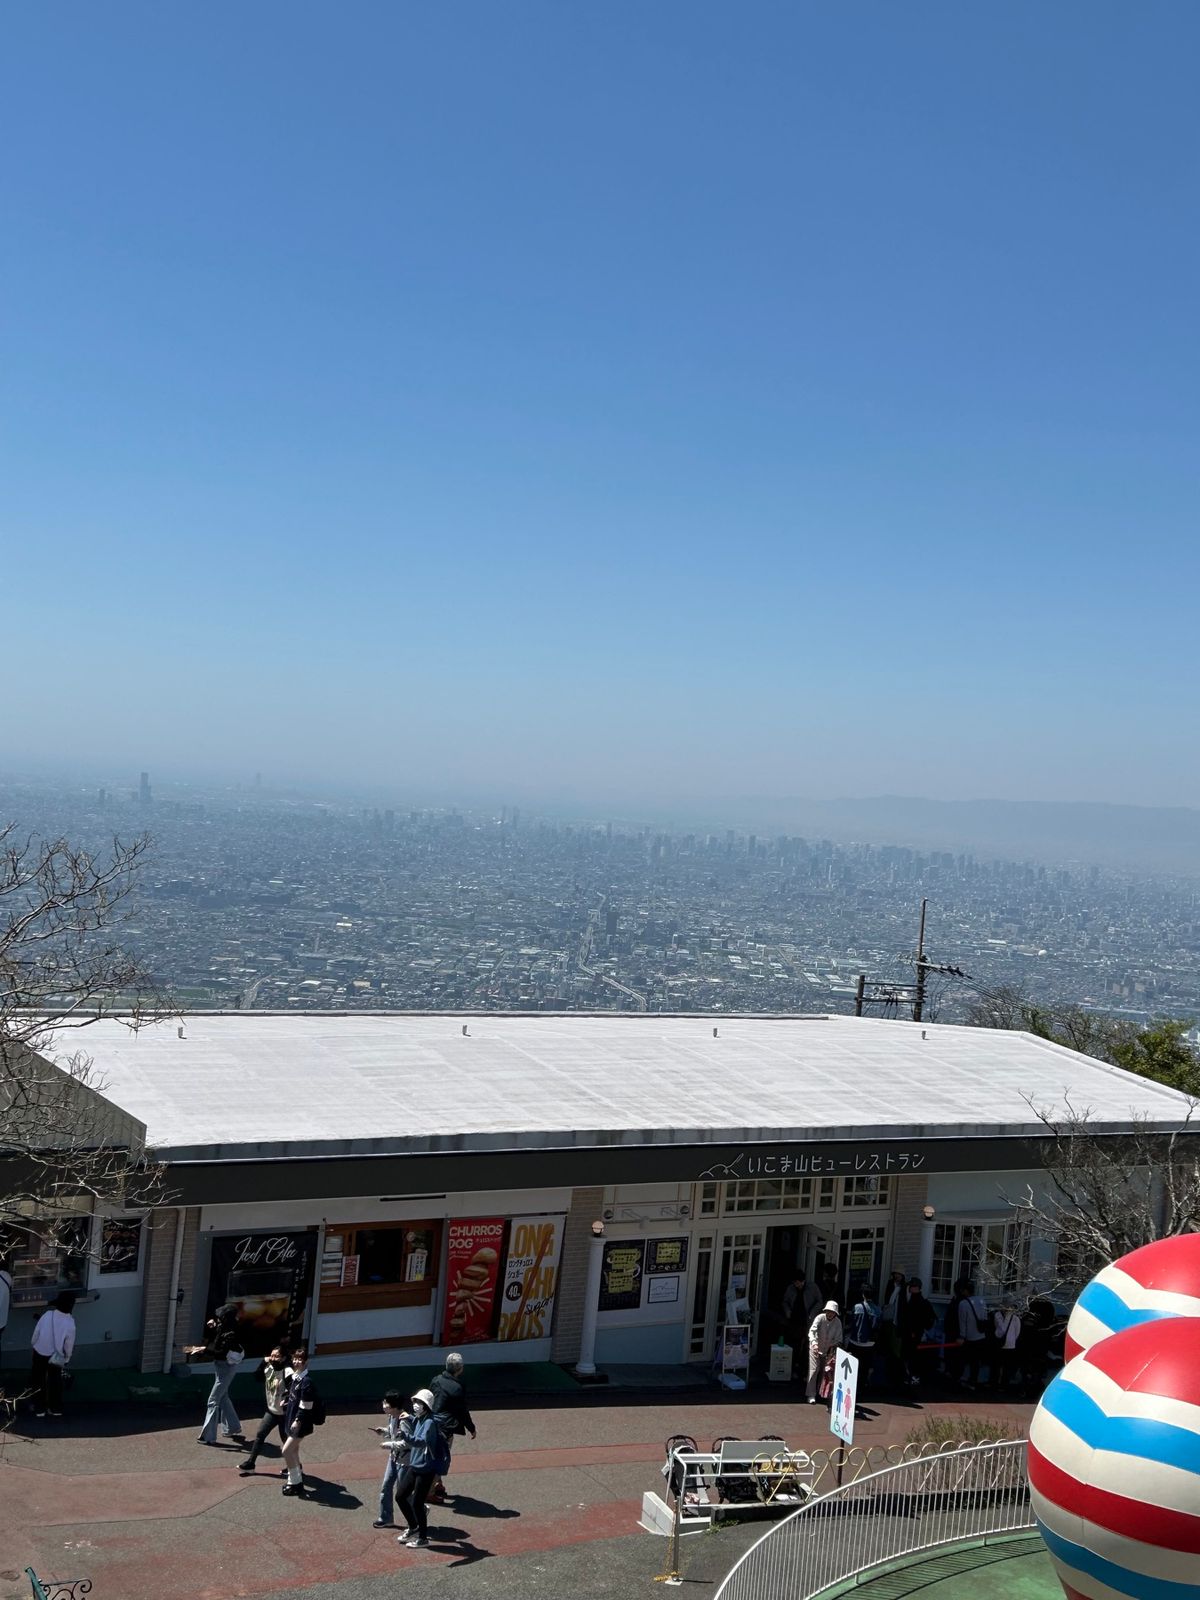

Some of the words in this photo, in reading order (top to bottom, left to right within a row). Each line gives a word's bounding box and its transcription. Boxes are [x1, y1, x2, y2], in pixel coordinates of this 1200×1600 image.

[748, 1153, 925, 1173] いこま山ビューレストラン
[449, 1224, 503, 1237] CHURROS
[449, 1239, 473, 1248] DOG
